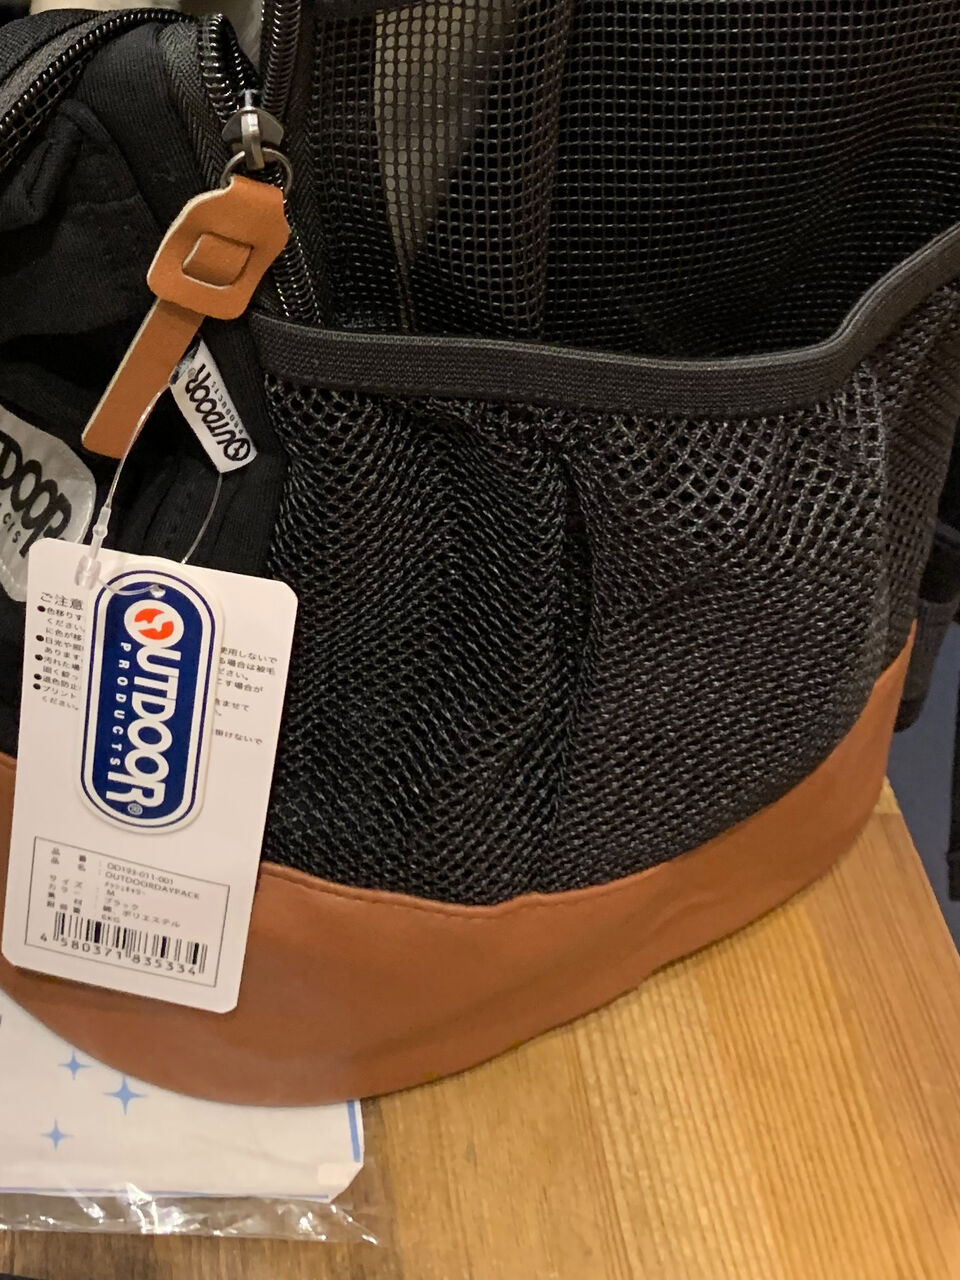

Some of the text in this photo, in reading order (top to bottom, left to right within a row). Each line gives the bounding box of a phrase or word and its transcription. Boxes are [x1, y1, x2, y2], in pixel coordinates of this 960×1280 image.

[183, 363, 251, 462] OUTDOOR
[105, 599, 185, 808] OUTDOOR
[109, 641, 132, 767] PRODUCTS
[40, 933, 48, 942] 4
